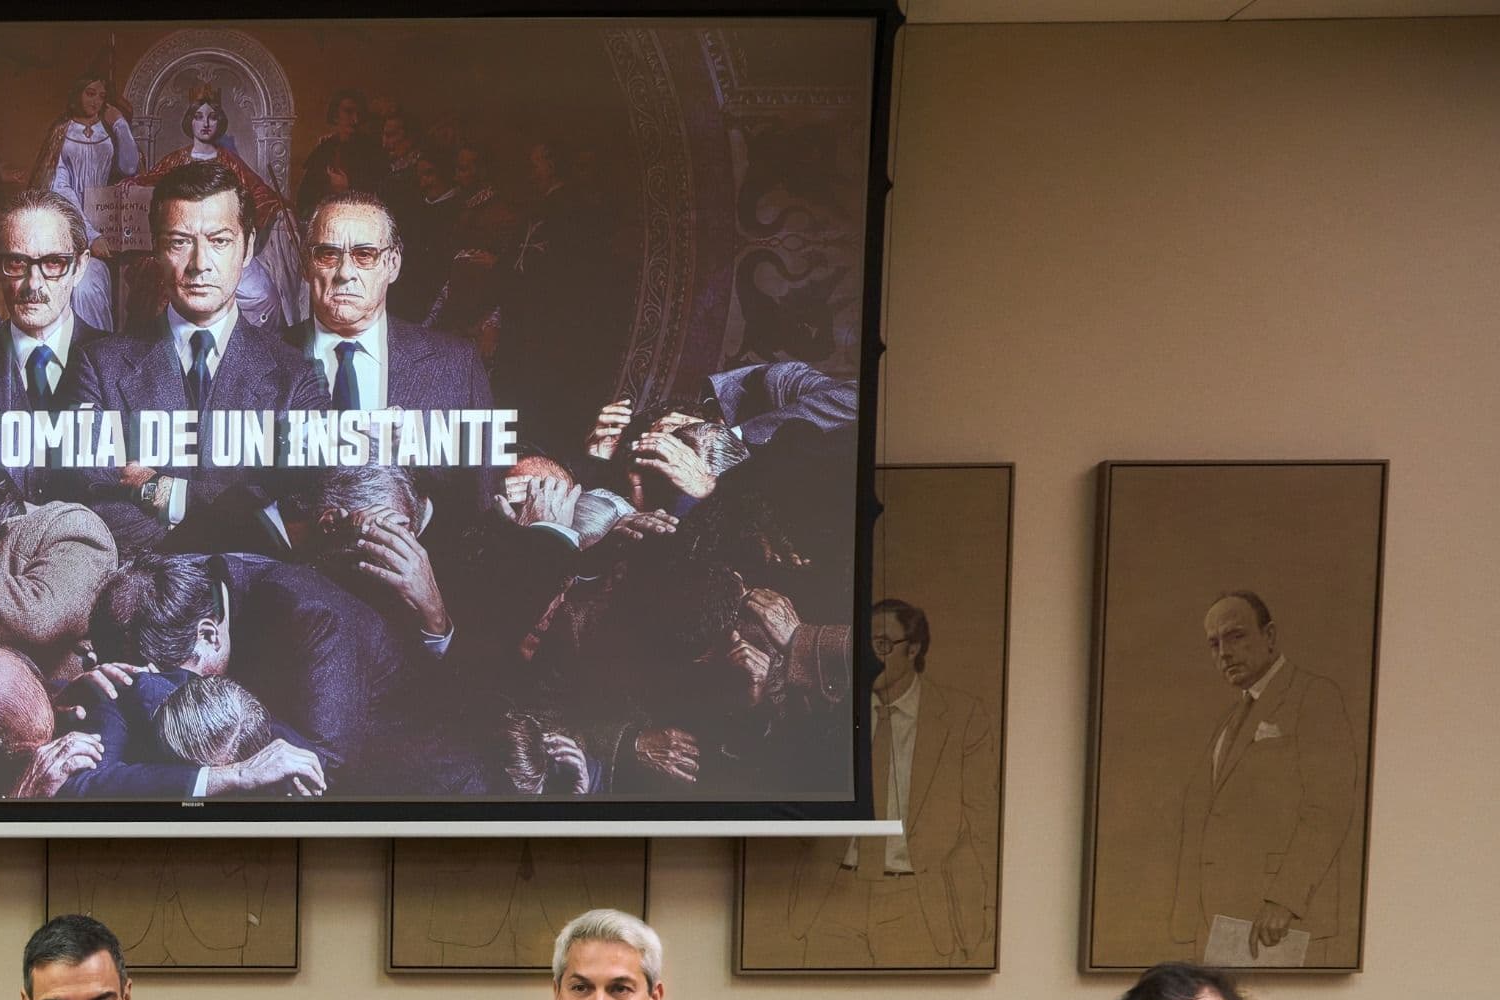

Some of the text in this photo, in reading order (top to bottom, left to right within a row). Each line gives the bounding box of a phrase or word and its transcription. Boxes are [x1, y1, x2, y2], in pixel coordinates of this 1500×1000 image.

[139, 410, 197, 467] DE
[211, 410, 274, 467] UN
[287, 408, 518, 466] INSTANTE
